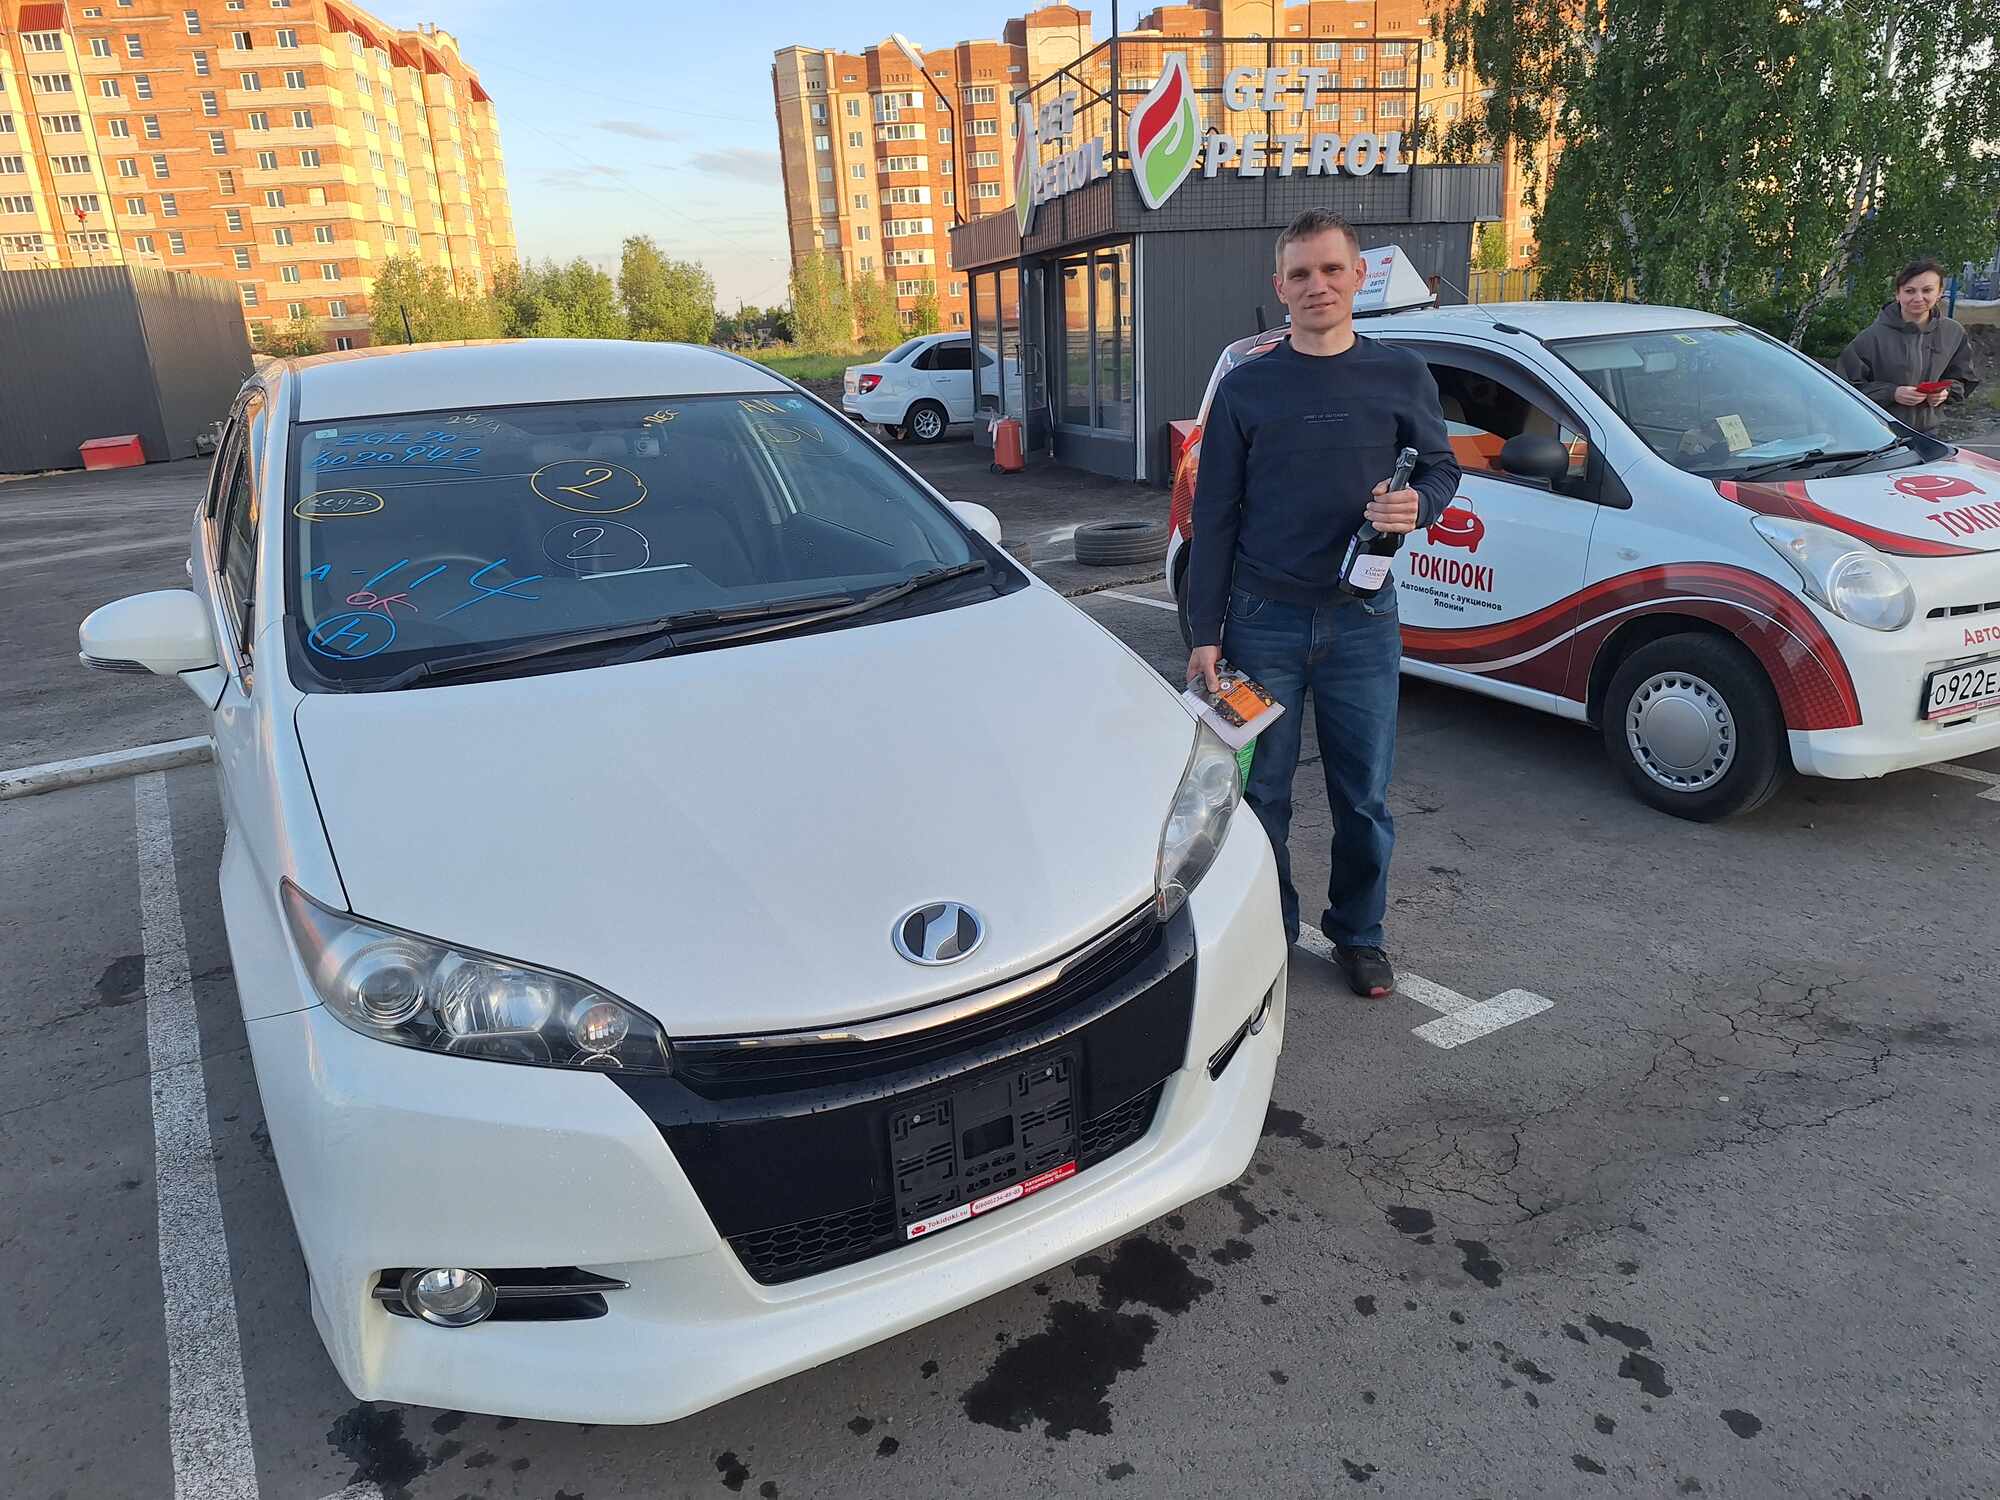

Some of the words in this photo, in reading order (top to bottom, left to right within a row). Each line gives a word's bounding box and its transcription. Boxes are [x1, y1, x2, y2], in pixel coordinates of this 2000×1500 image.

[1223, 66, 1328, 111] GET
[1203, 131, 1410, 178] PETROL
[1033, 137, 1108, 206] PETROL
[556, 468, 613, 499] 2
[1926, 502, 2000, 537] TOKID
[566, 527, 616, 559] 2
[1409, 551, 1494, 592] TOKIDOKI
[346, 591, 418, 619] OK
[1400, 580, 1449, 599] Автомобили
[1450, 593, 1455, 601] с
[1456, 593, 1503, 611] аукционов
[1433, 598, 1464, 613] Японии
